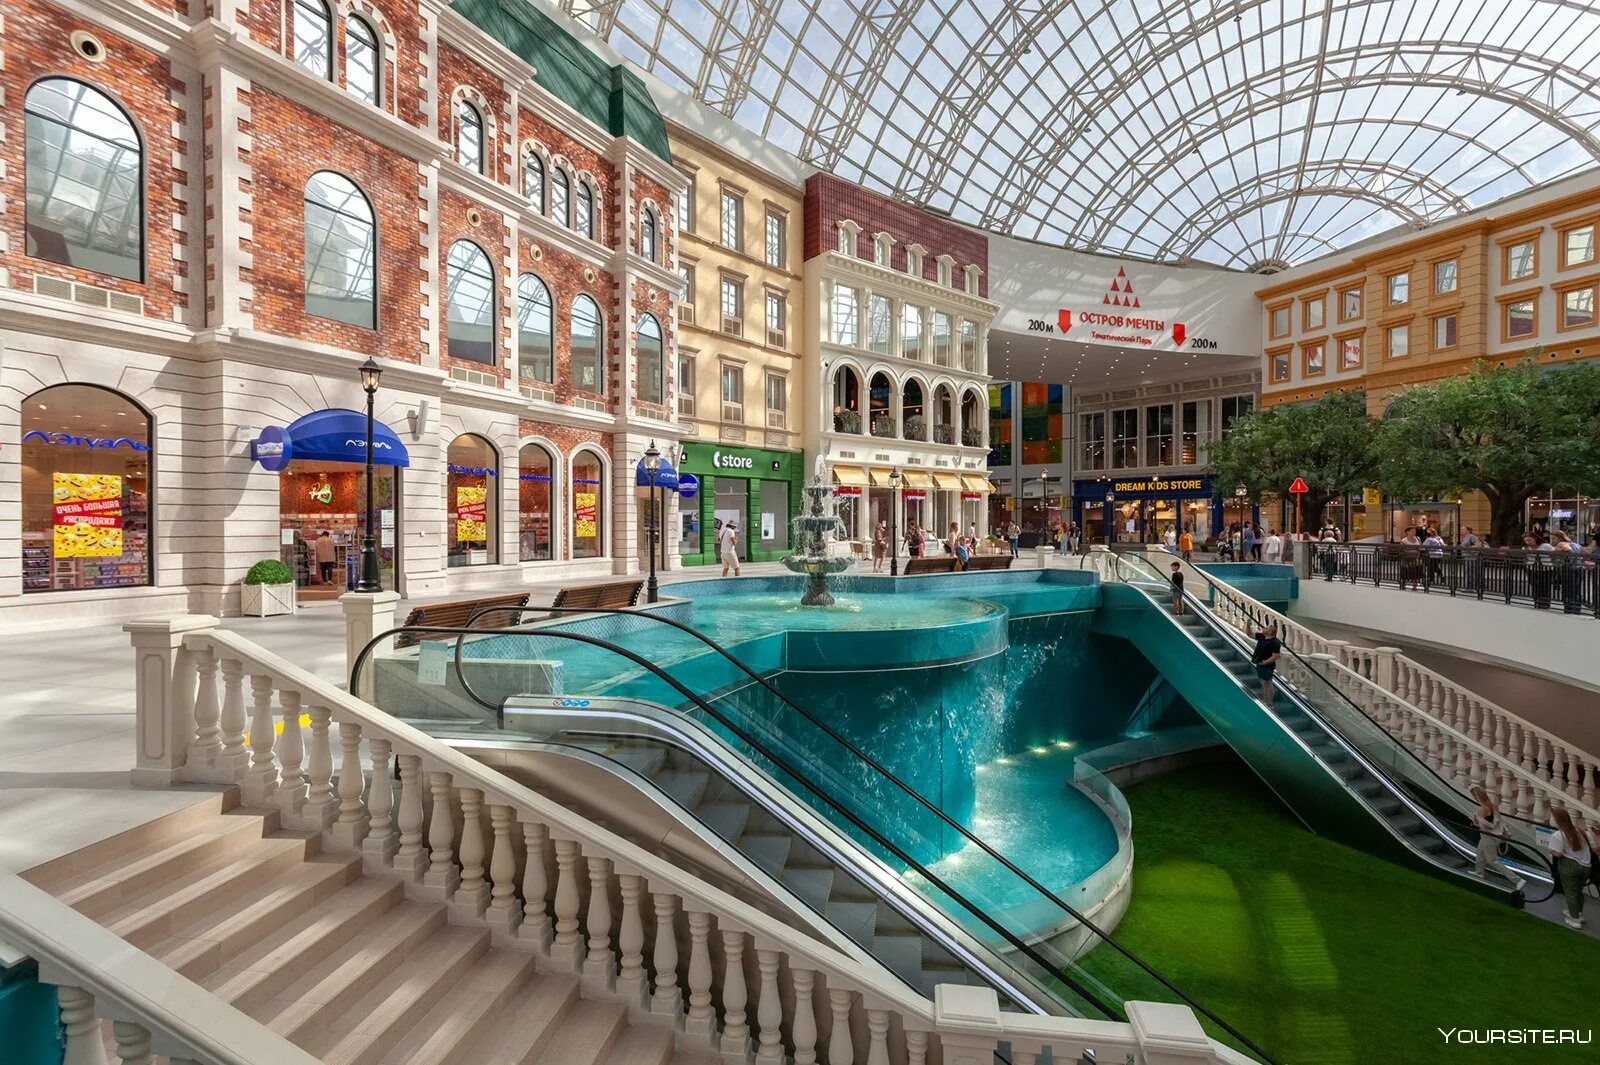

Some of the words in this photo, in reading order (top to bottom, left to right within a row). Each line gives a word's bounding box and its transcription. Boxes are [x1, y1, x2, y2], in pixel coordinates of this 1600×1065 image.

[1080, 312, 1123, 326] ОСТРОВ
[1126, 318, 1164, 331] МЕЧТЫ
[1091, 331, 1136, 343] Тематический
[1137, 336, 1152, 346] Парк
[1115, 483, 1145, 491] DREAM
[1147, 481, 1169, 490] KDS
[1171, 480, 1201, 489] STORE
[56, 502, 82, 515] ОЧЕНЬ
[83, 500, 119, 511] БОЛЬШАЯ
[63, 515, 116, 526] РАСПРОДАЖА
